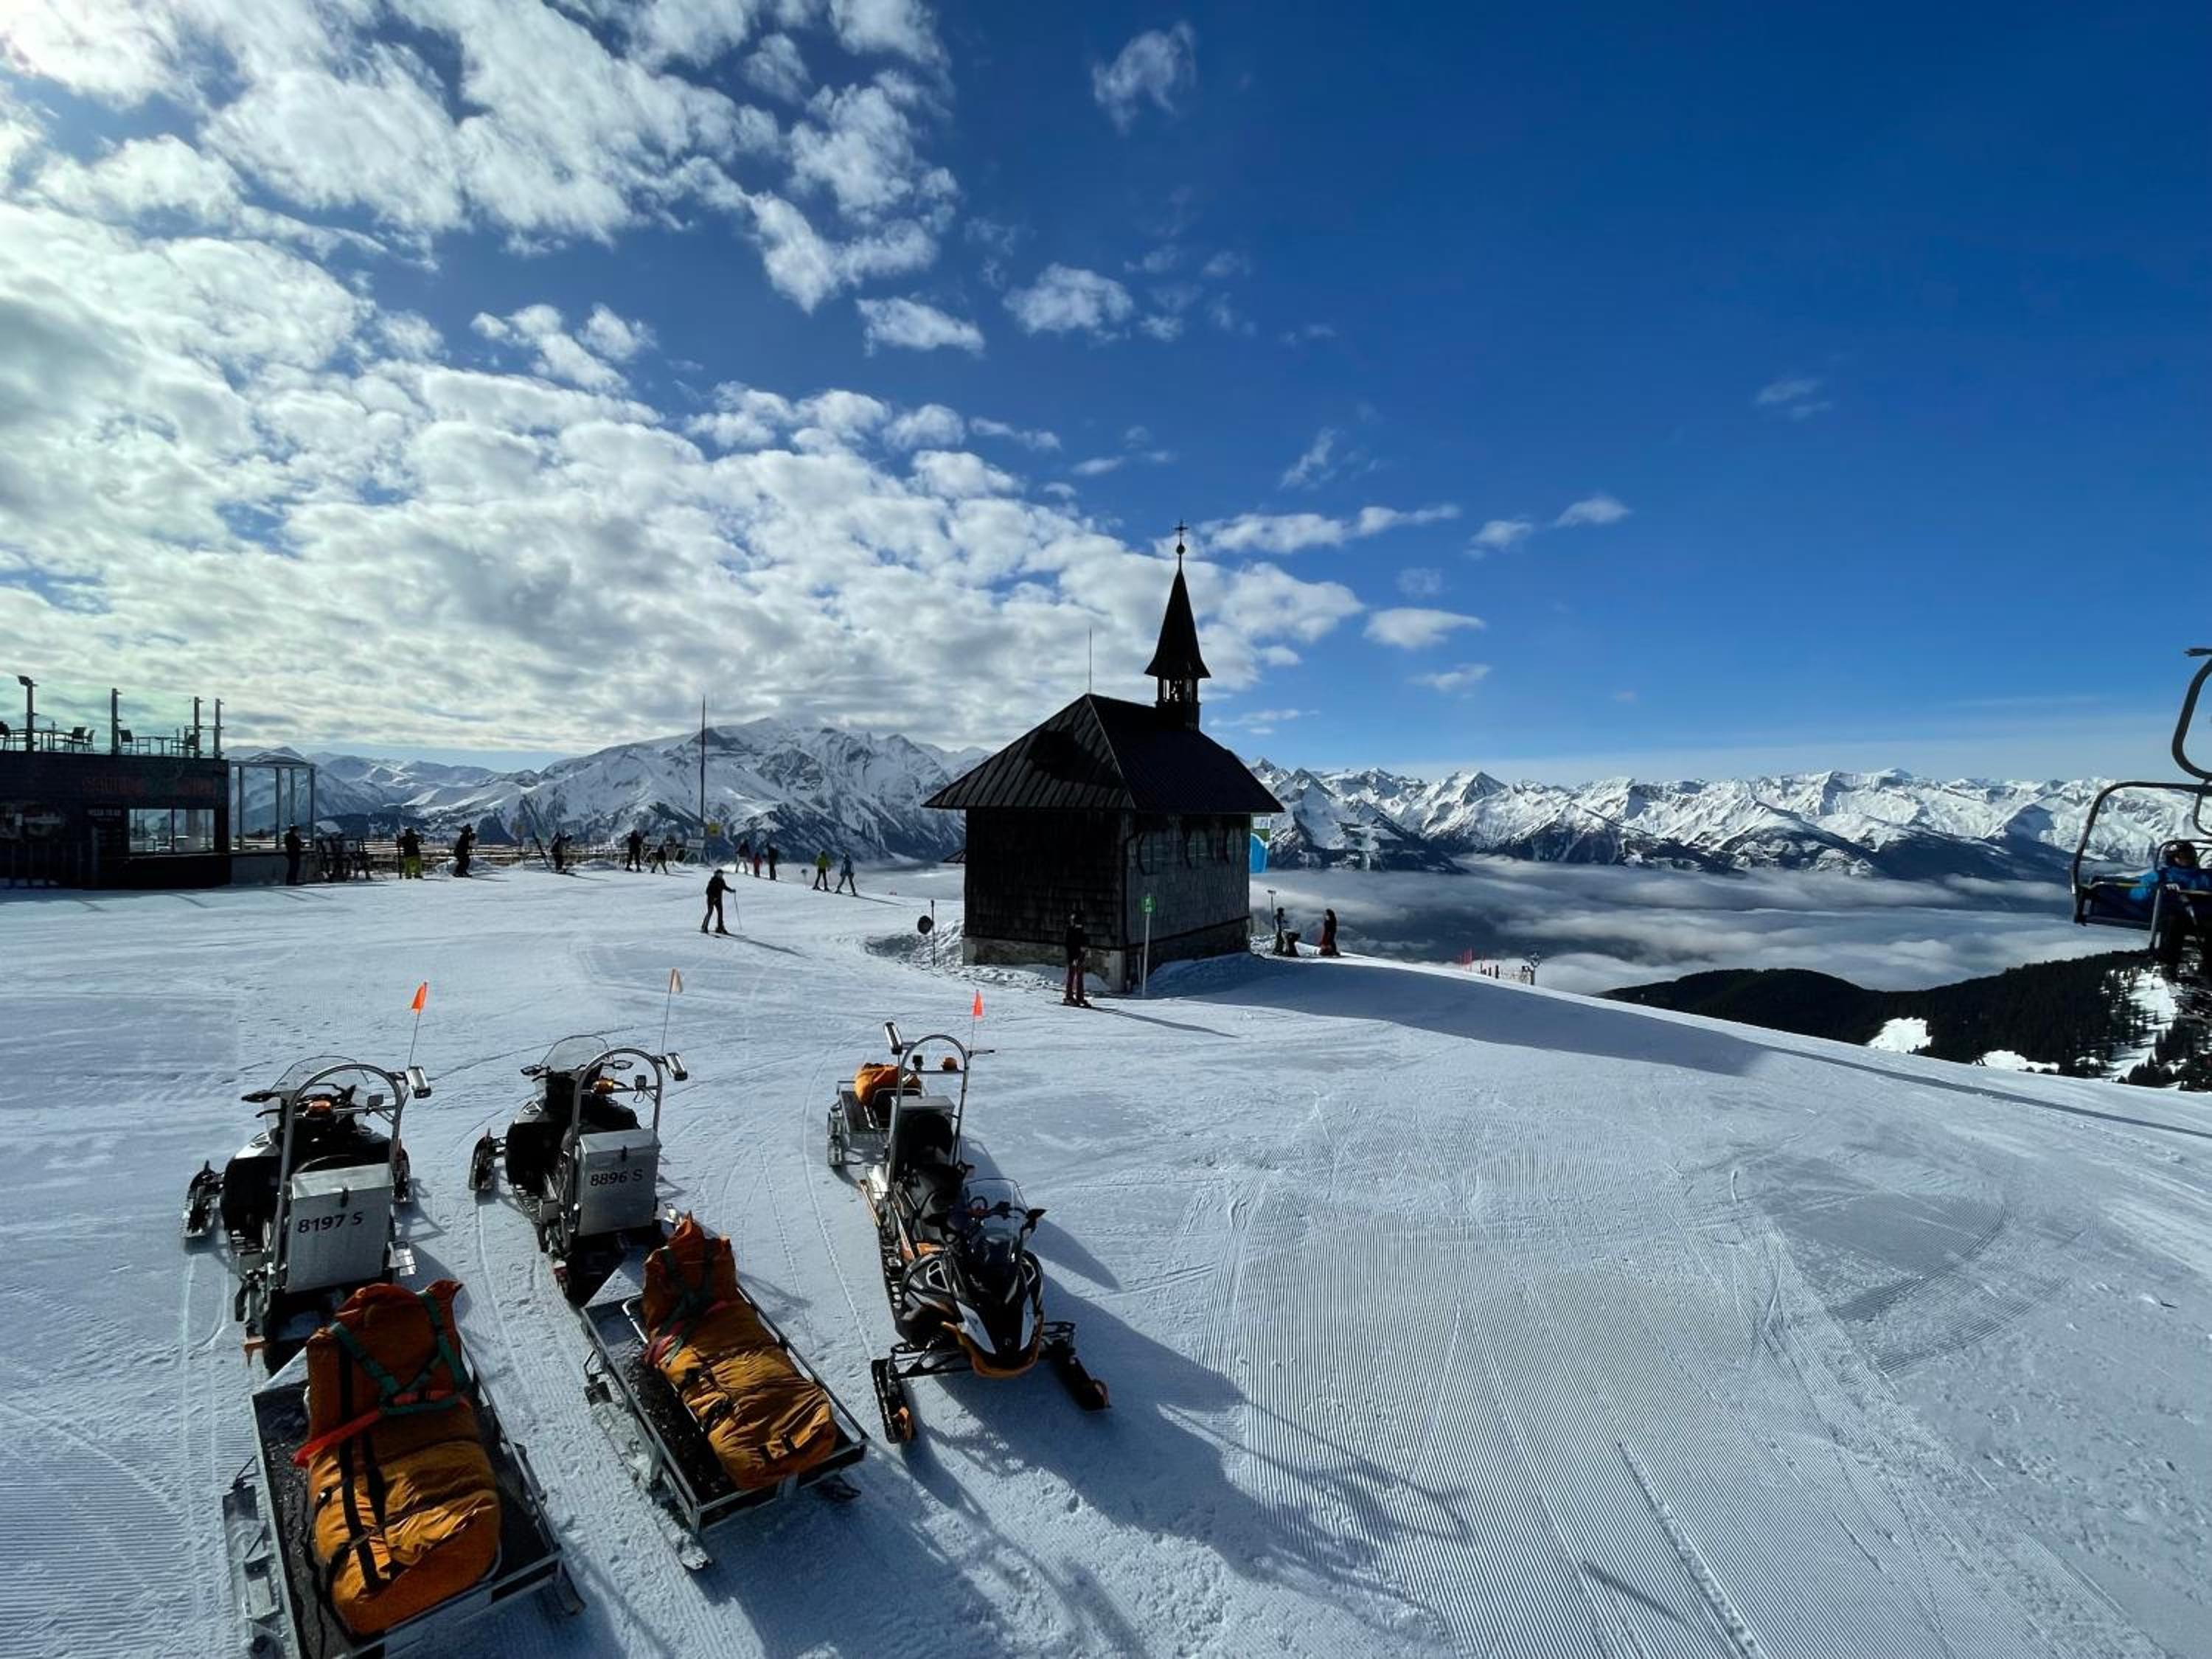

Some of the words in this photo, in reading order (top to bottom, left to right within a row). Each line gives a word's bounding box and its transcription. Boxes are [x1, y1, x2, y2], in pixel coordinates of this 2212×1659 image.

[590, 1171, 627, 1186] 8896
[632, 1169, 644, 1181] S
[297, 1213, 345, 1234] 8197
[352, 1211, 364, 1225] S
